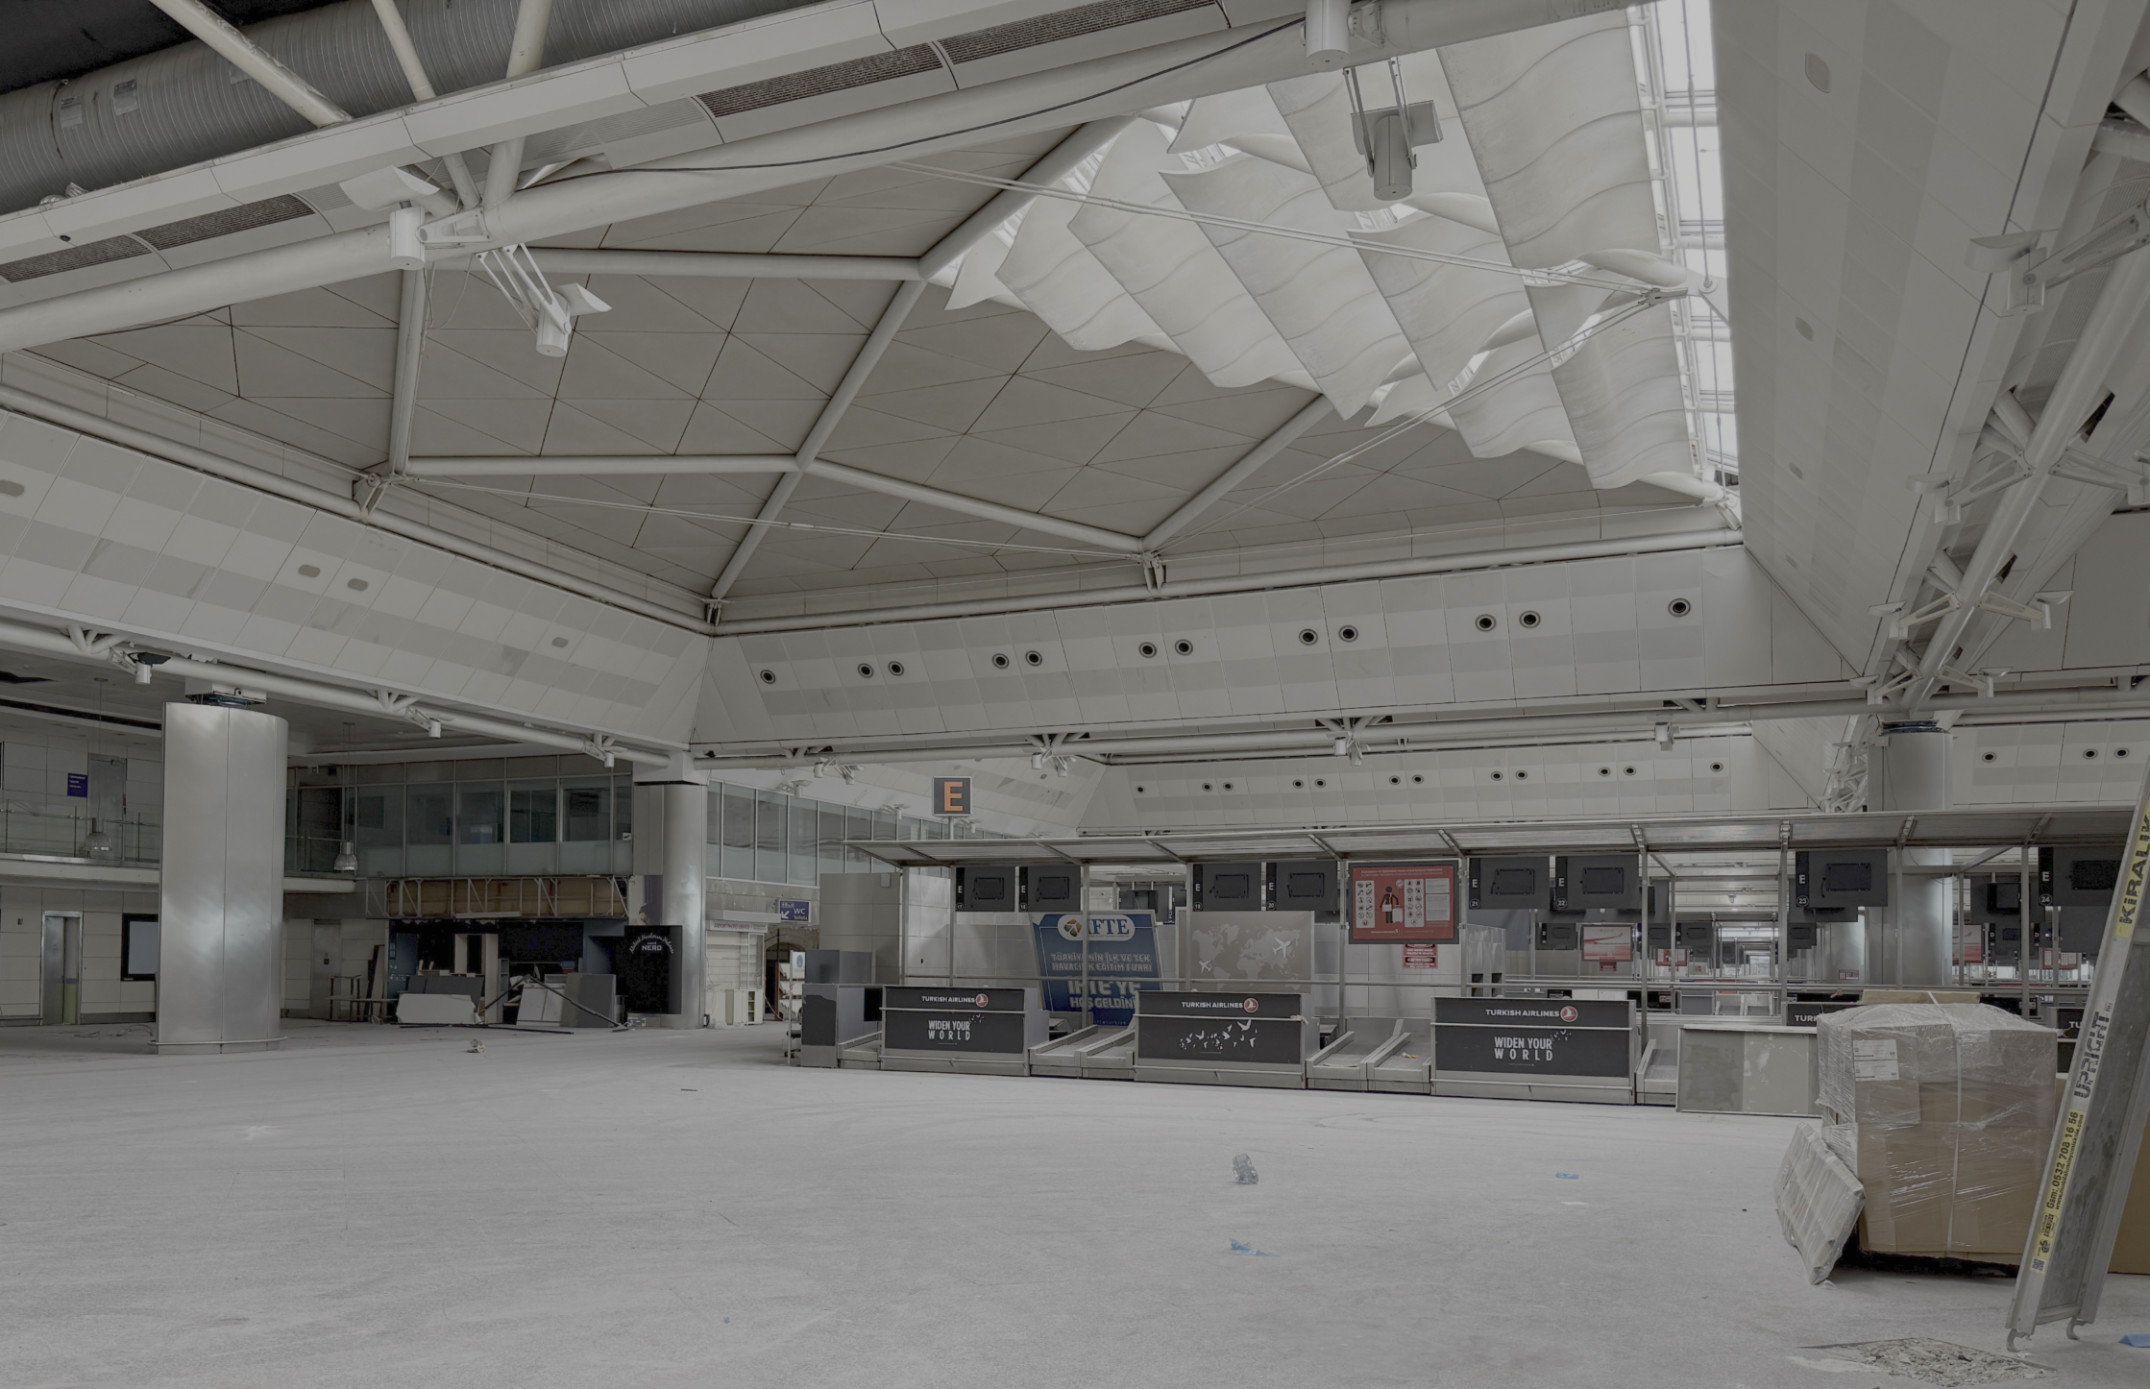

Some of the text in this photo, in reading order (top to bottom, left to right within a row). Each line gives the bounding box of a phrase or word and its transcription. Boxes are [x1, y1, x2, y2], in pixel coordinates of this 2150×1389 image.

[943, 781, 963, 812] E
[1798, 874, 1806, 884] E
[2042, 871, 2050, 882] E
[1195, 883, 1201, 892] E
[1268, 882, 1274, 890] E
[1472, 879, 1478, 888] E
[1558, 878, 1565, 887] E
[1119, 953, 1132, 962] VE
[1132, 954, 1151, 962] TEK
[928, 1020, 970, 1031] WIDEN YOUR
[1494, 1036, 1553, 1050] WIDEN YOUR
[2073, 1011, 2110, 1098] UPRIGHT
[2068, 1111, 2079, 1124] 56
[2064, 1126, 2075, 1138] 16
[2058, 1141, 2071, 1160] 708
[2052, 1162, 2065, 1187] 0532
[2046, 1188, 2058, 1209] Gsm:
